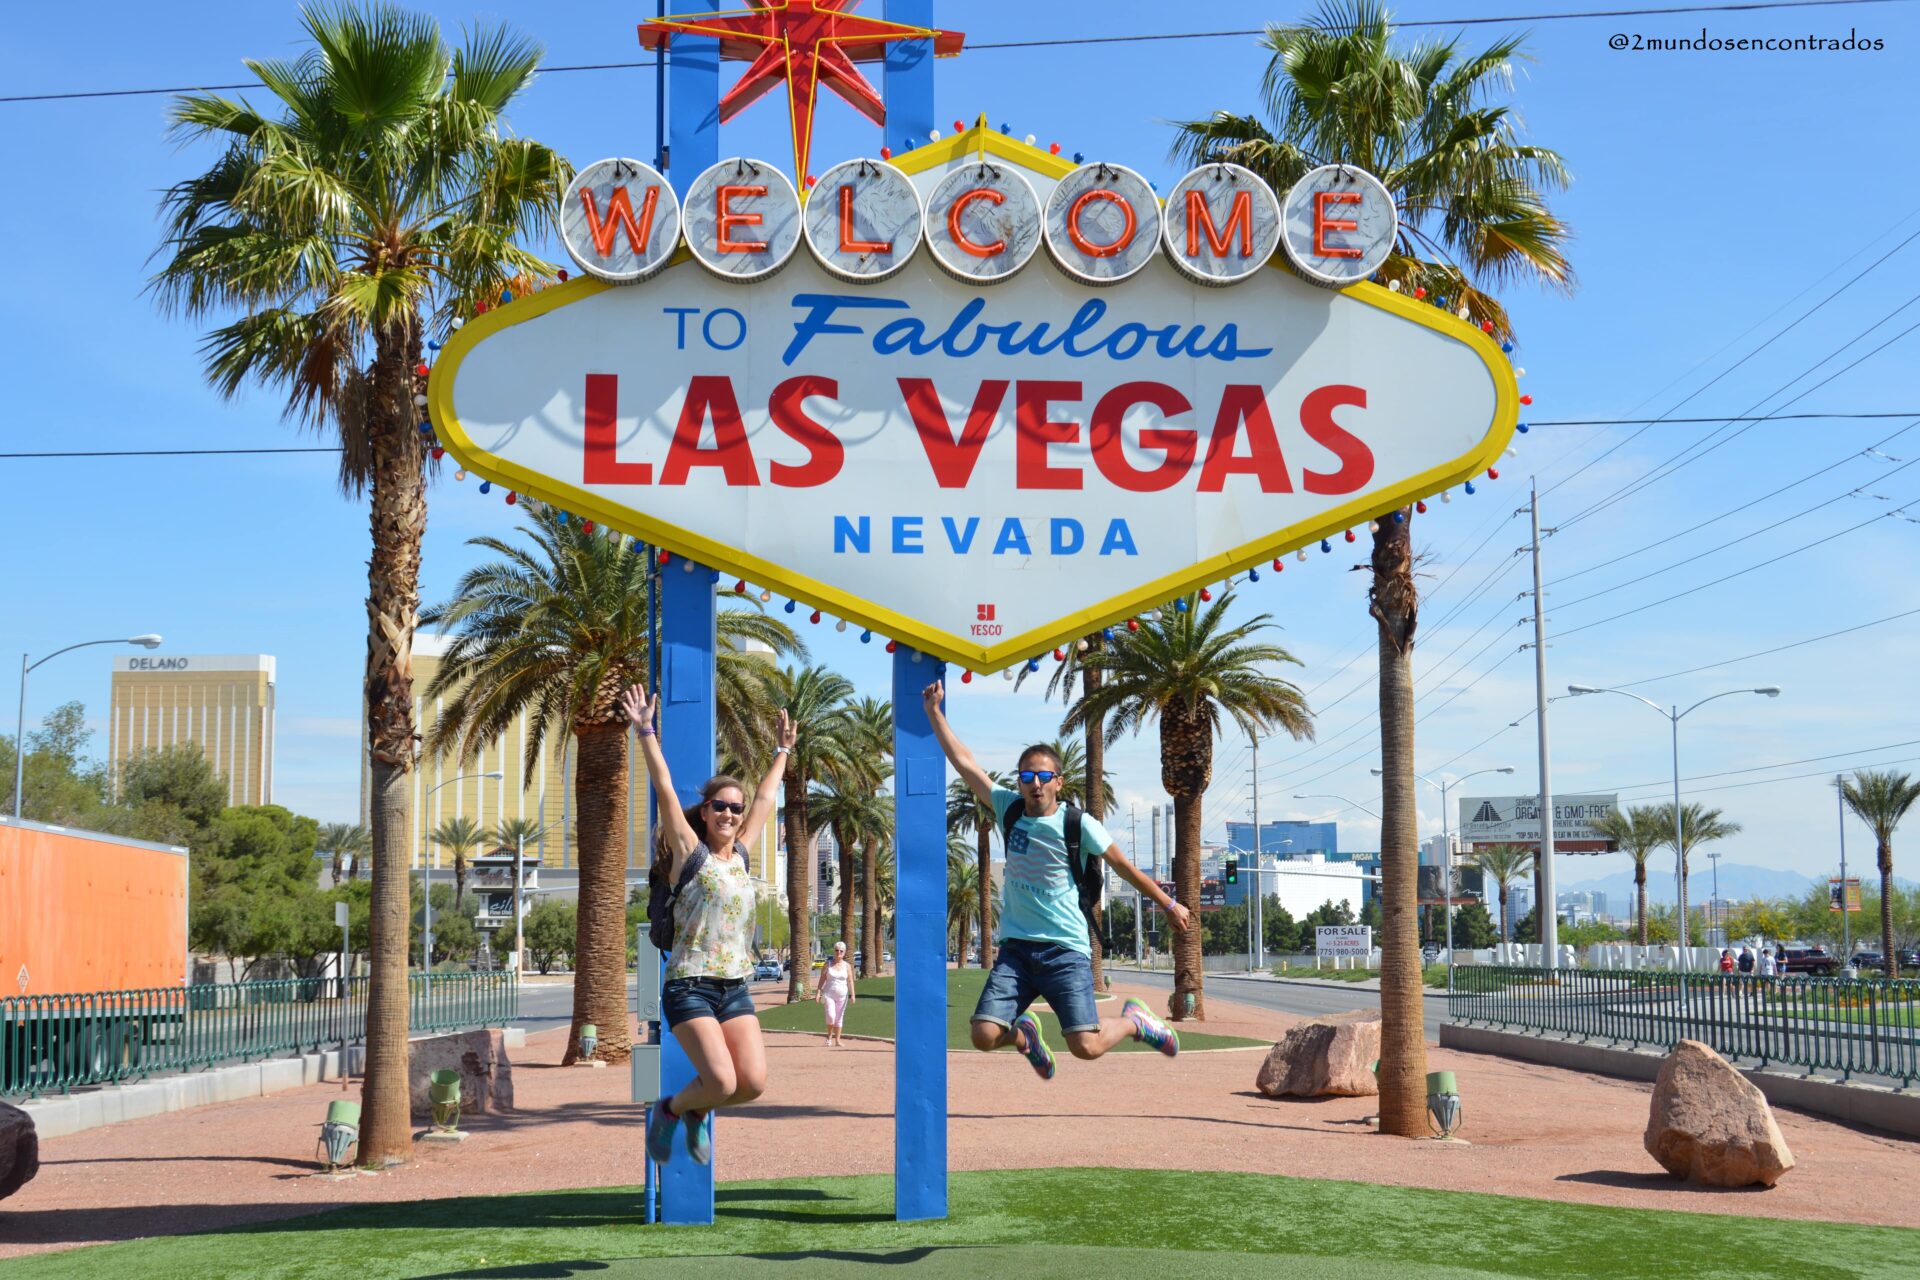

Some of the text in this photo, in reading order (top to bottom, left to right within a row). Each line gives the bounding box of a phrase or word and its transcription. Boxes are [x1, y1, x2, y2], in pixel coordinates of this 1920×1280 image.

[580, 184, 1362, 259] WELCOME
[663, 294, 1273, 366] TO Fabulous
[584, 375, 1374, 494] LAS VEGAS
[834, 515, 1139, 557] NEVADA
[970, 624, 1002, 636] YESCO
[129, 657, 189, 671] DELANO
[1555, 806, 1562, 819] &
[1351, 853, 1375, 861] MGM
[1318, 928, 1367, 936] FOR SALE
